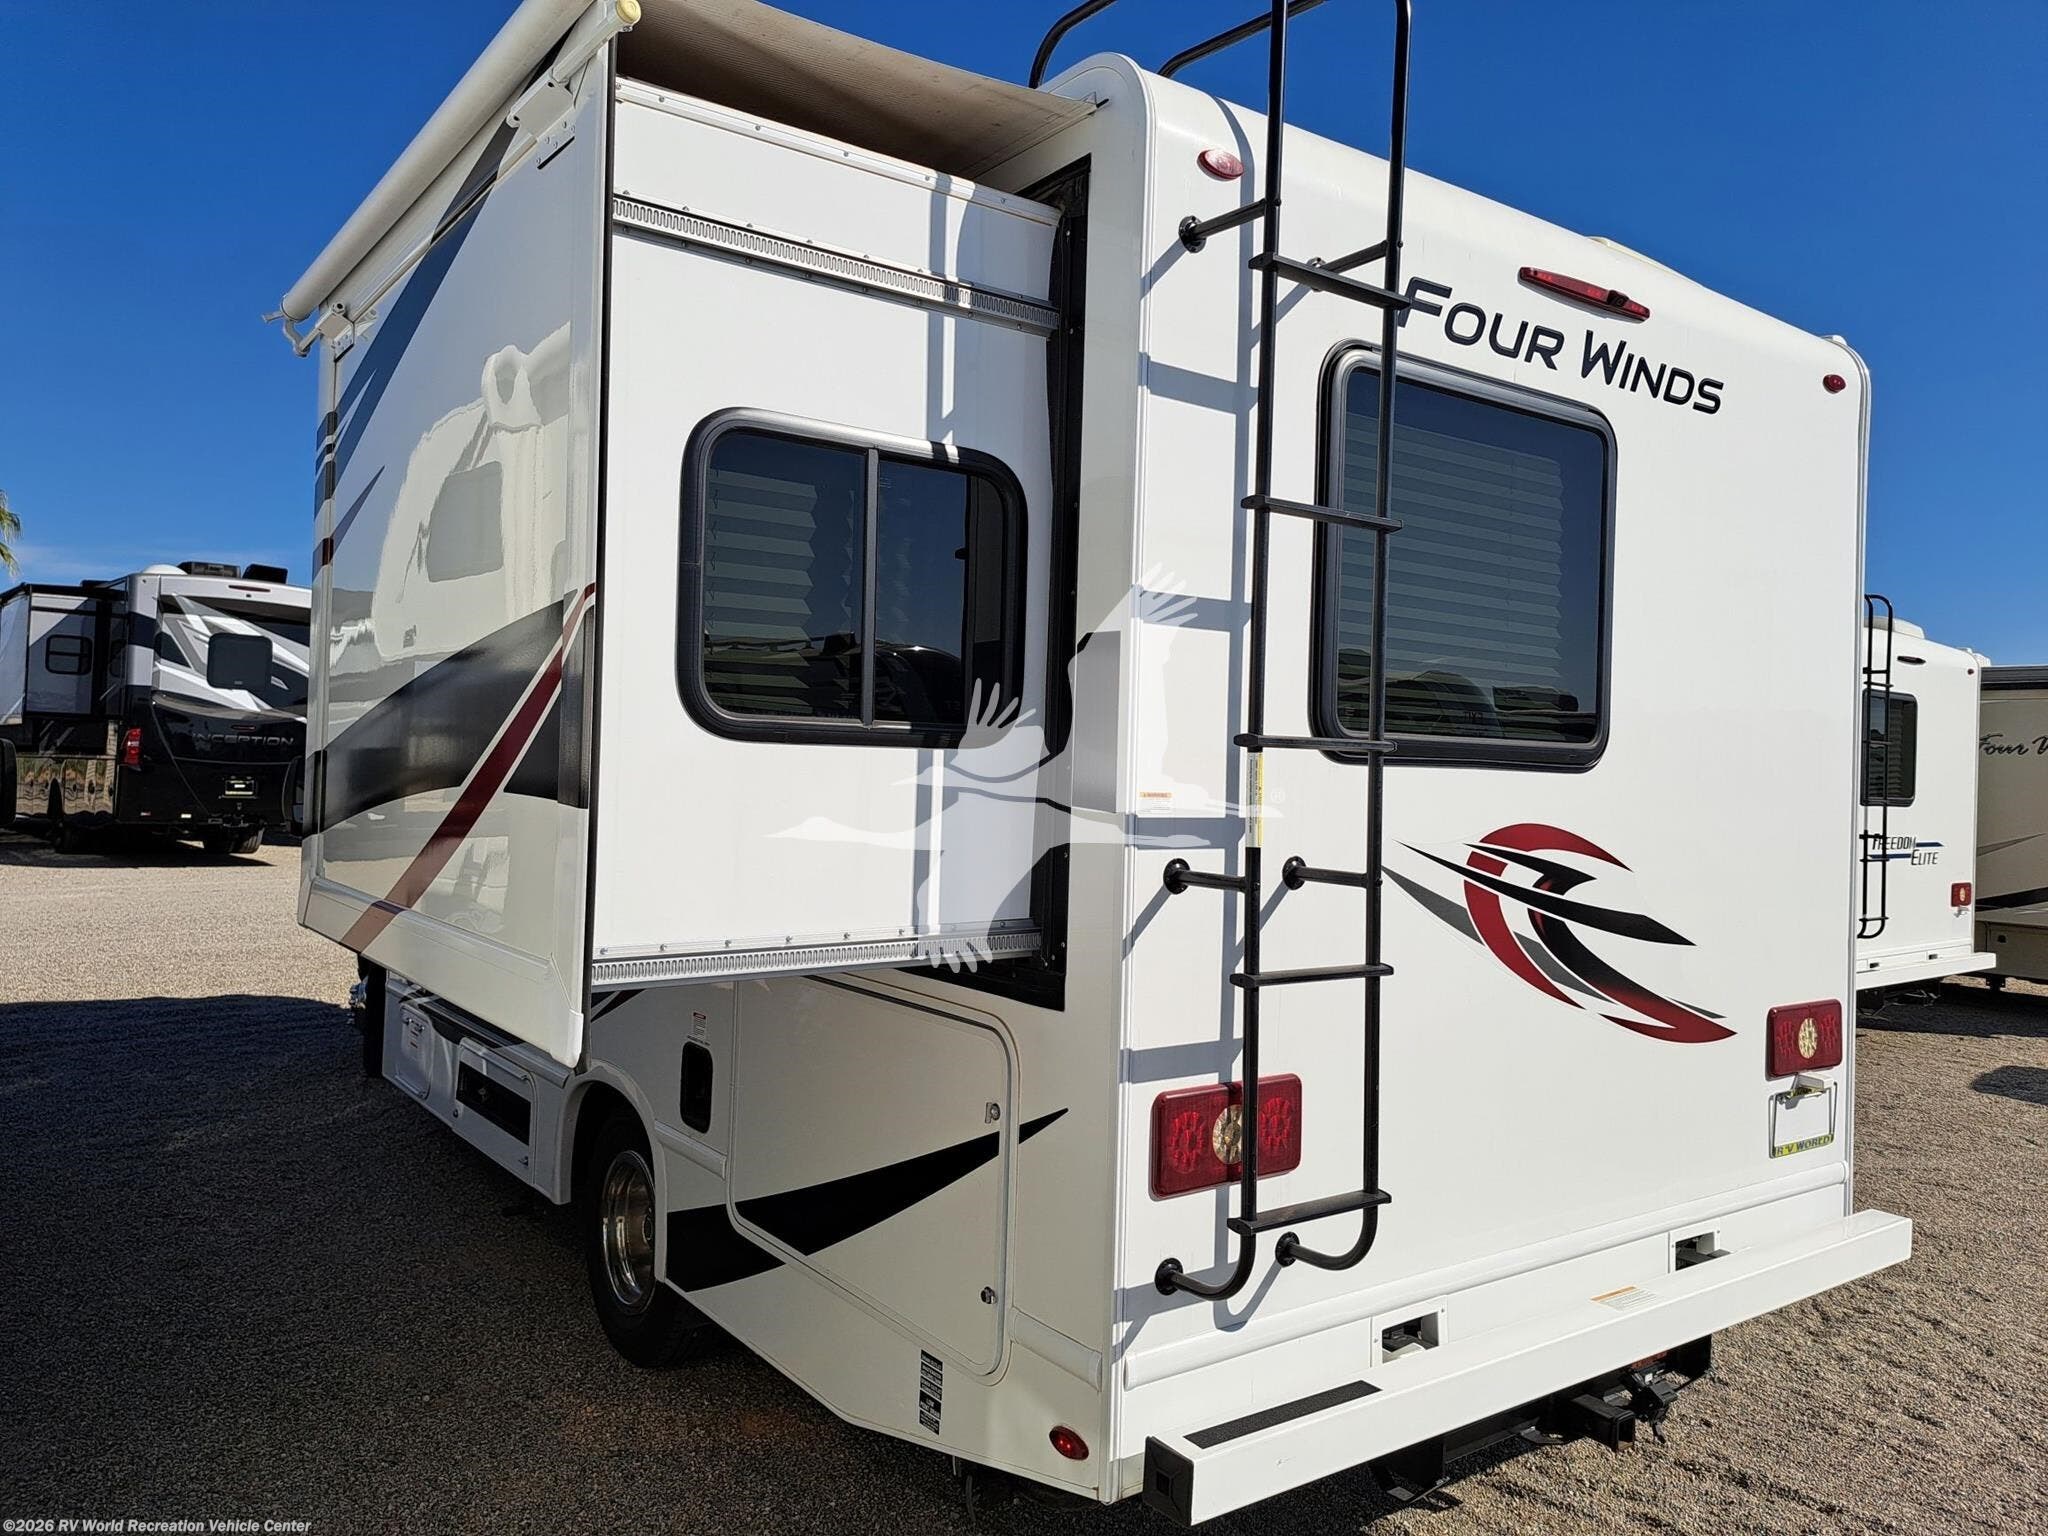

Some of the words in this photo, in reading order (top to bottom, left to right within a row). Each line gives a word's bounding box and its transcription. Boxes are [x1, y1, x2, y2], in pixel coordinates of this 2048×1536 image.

[1397, 275, 1565, 371] FOUR
[1580, 328, 1725, 415] WINDS
[1911, 848, 1939, 866] ELITE
